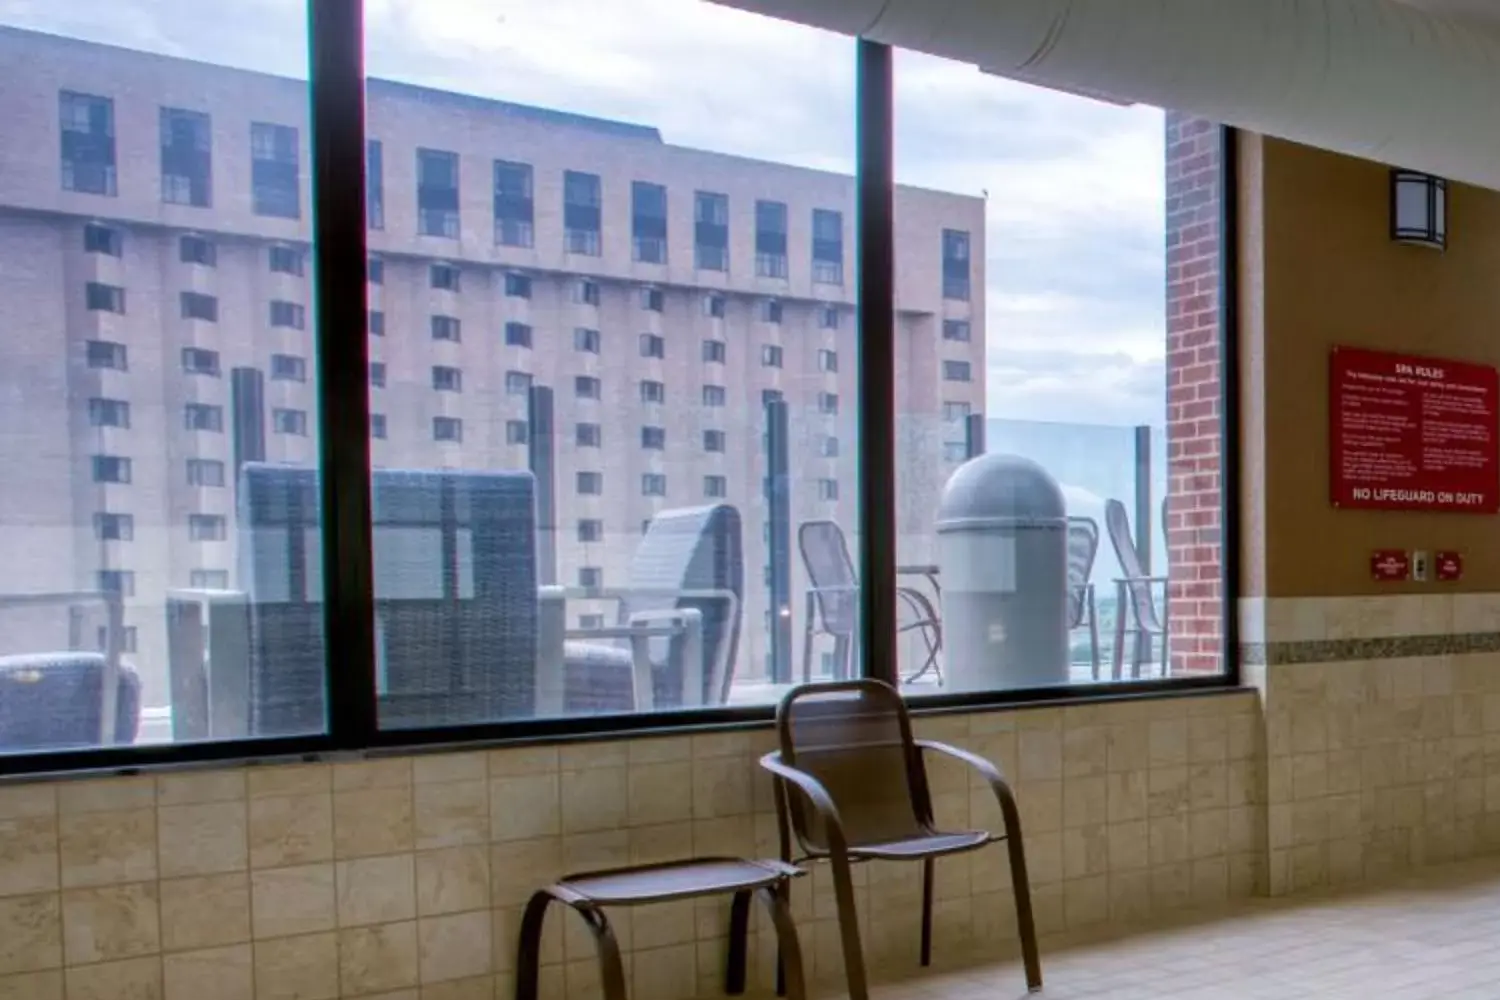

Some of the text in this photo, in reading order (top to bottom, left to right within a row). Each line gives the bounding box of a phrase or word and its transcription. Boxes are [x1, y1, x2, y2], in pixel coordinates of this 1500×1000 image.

[1395, 363, 1445, 379] SPA RULES
[1353, 487, 1484, 505] NO LIFEGUARD ON DUTY
